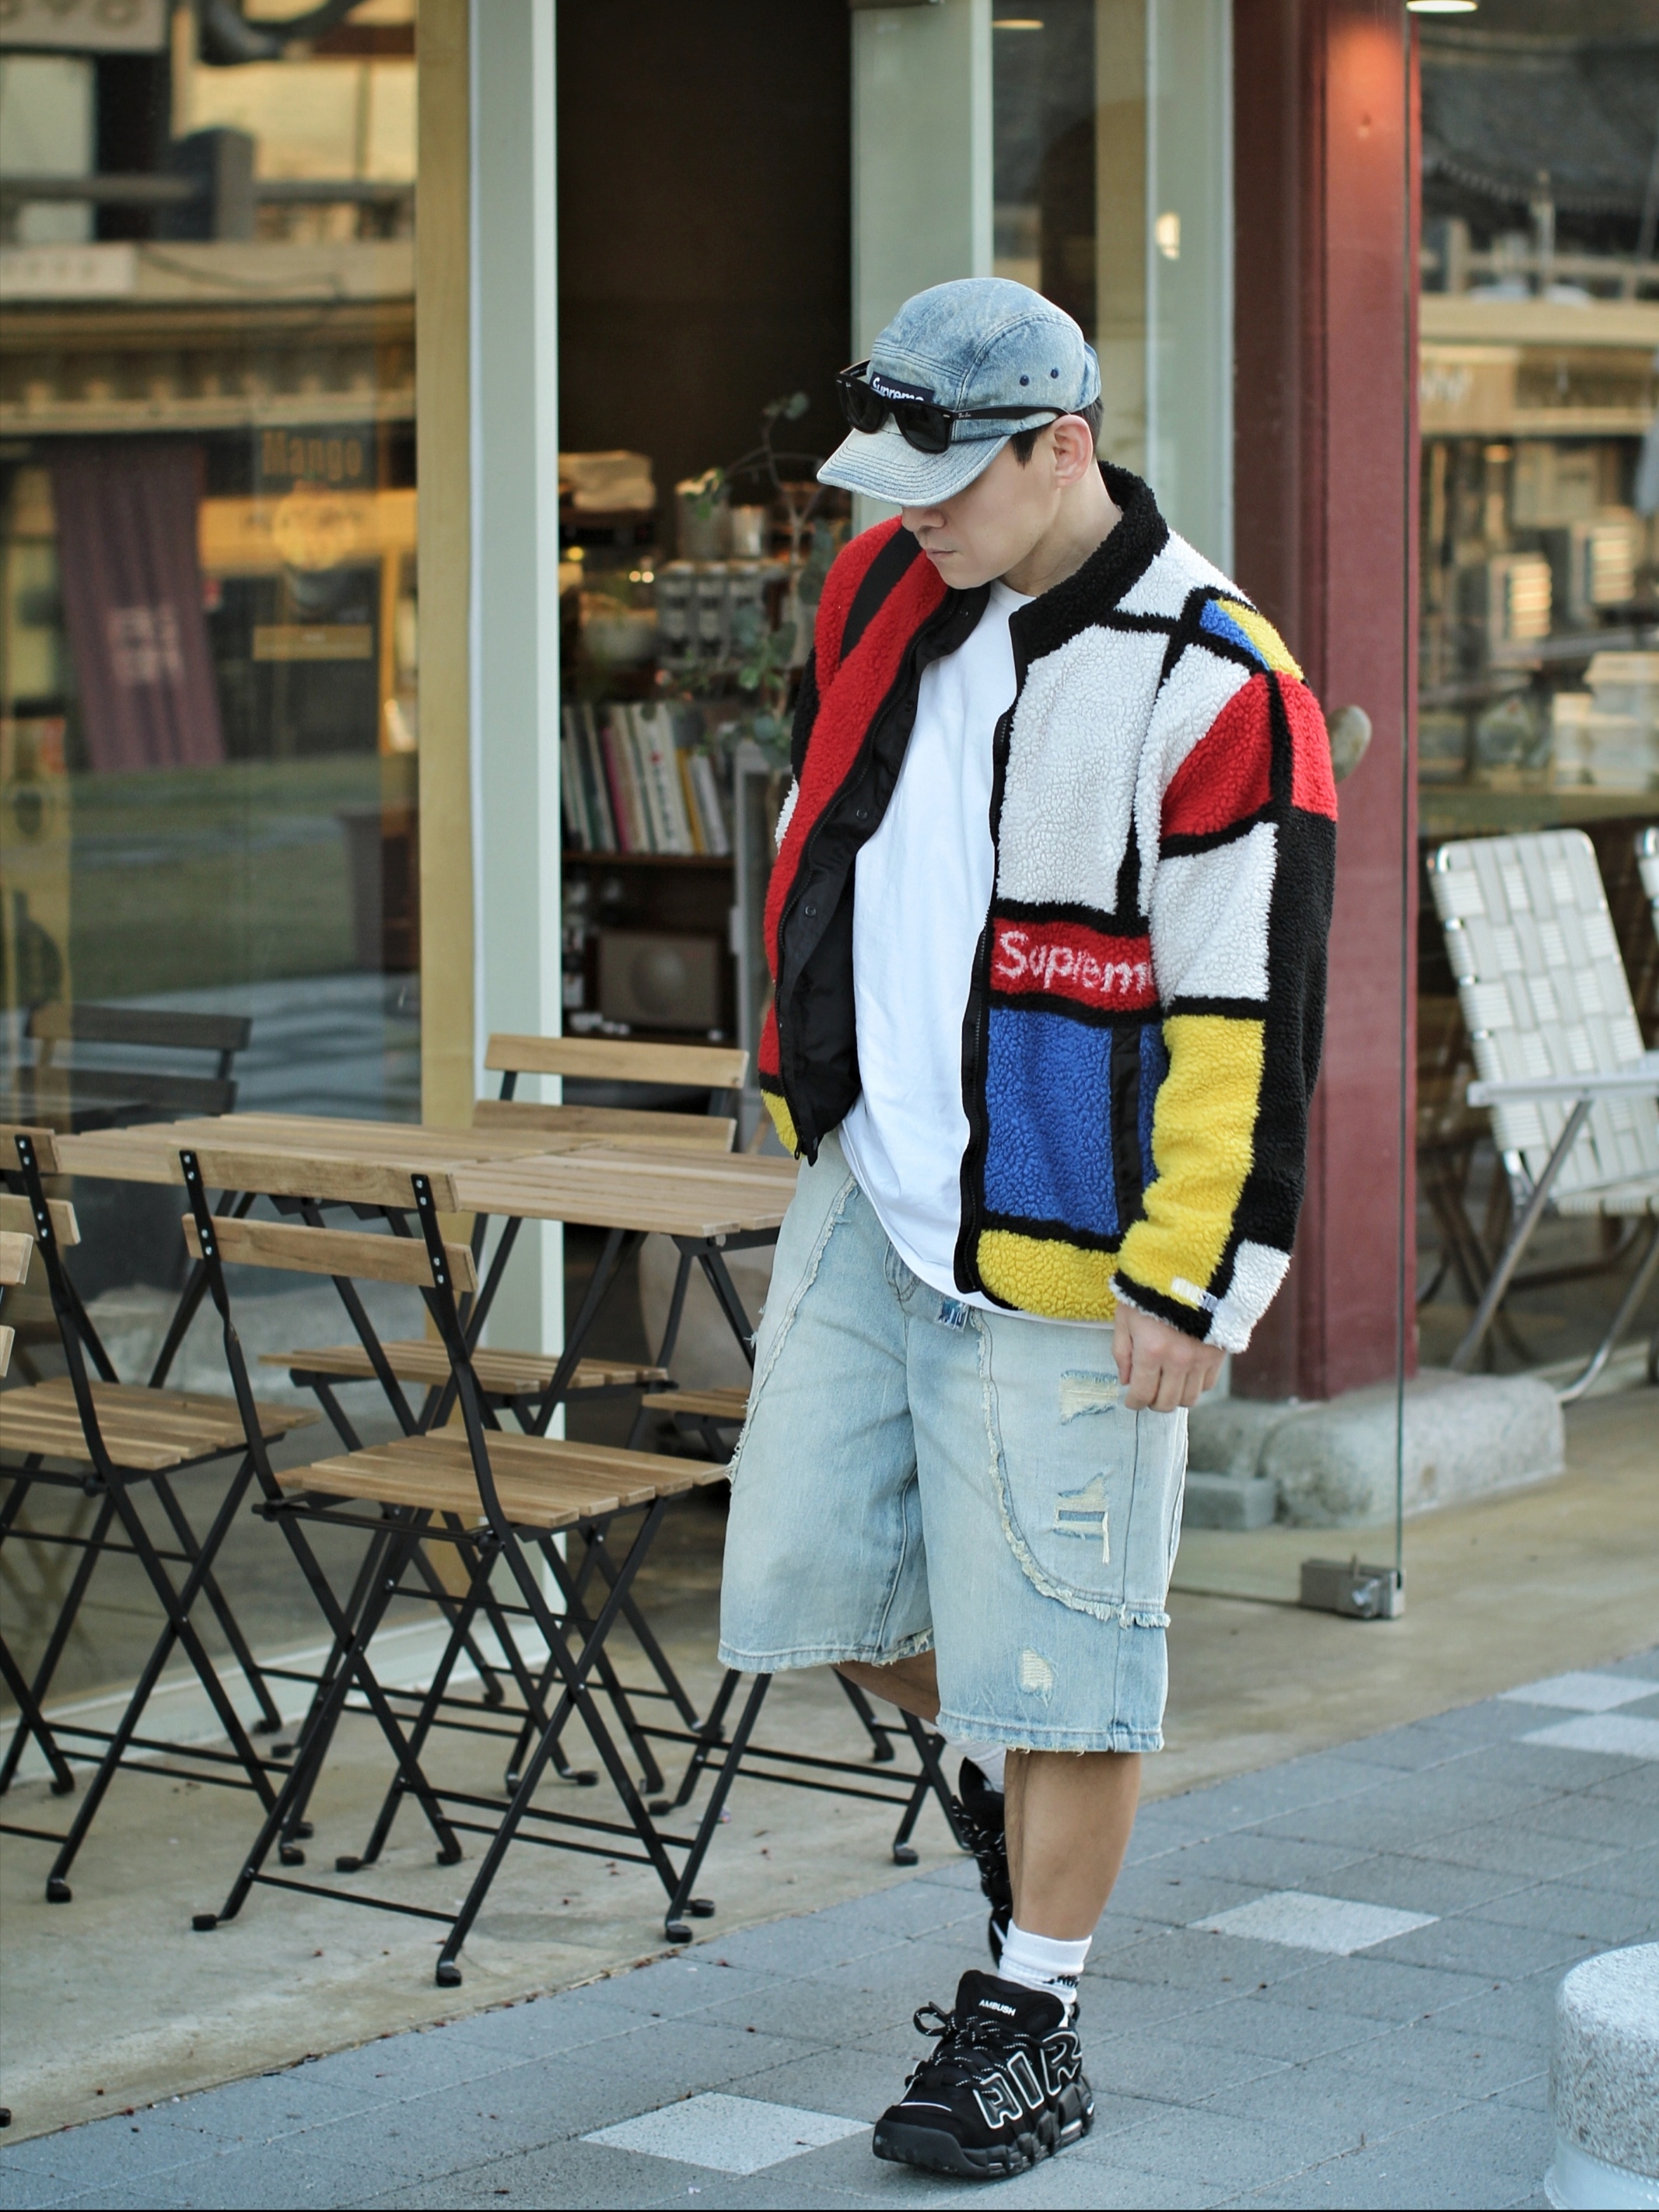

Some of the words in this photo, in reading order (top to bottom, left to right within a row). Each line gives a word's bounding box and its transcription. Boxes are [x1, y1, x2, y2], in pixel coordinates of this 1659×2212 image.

[262, 431, 363, 481] Mango
[996, 930, 1153, 994] Suprem
[978, 1999, 1017, 2017] AMBUSH
[972, 2030, 1083, 2130] AIR
